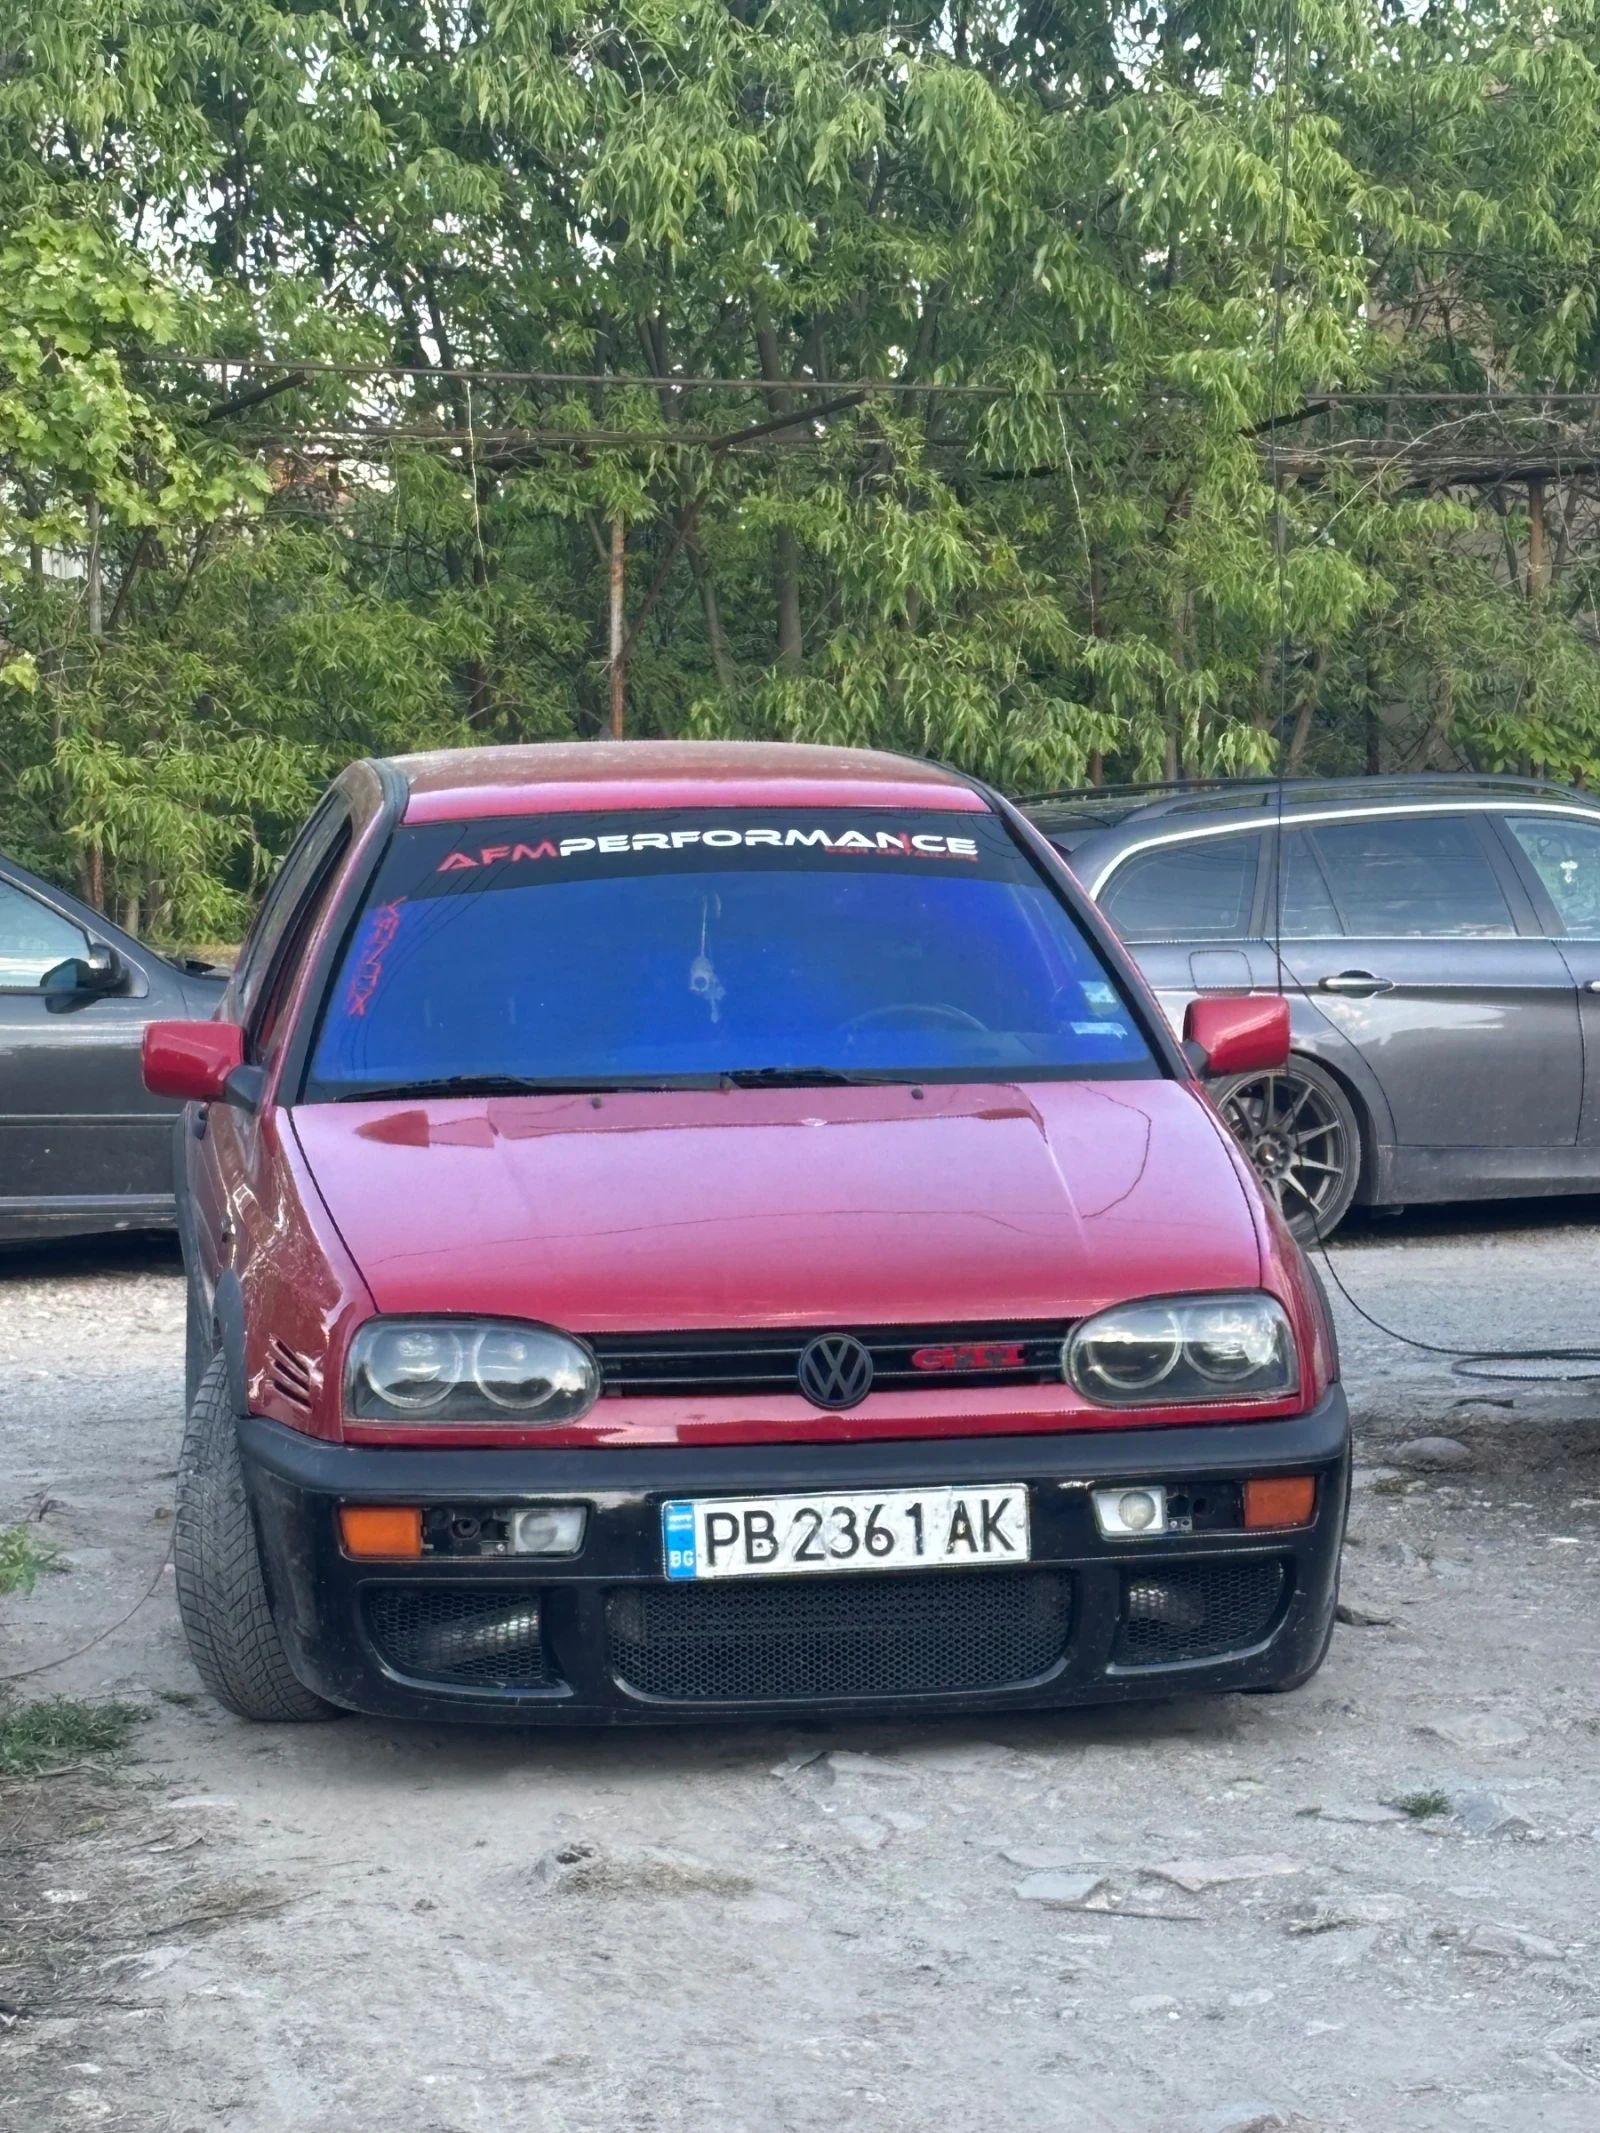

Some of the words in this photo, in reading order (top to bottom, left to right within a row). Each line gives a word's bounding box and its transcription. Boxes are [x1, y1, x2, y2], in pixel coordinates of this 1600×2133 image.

[911, 1344, 1025, 1371] GTI
[670, 1550, 694, 1567] BG
[705, 1509, 778, 1567] PB
[792, 1502, 925, 1561] 2361
[945, 1497, 1016, 1555] AK
